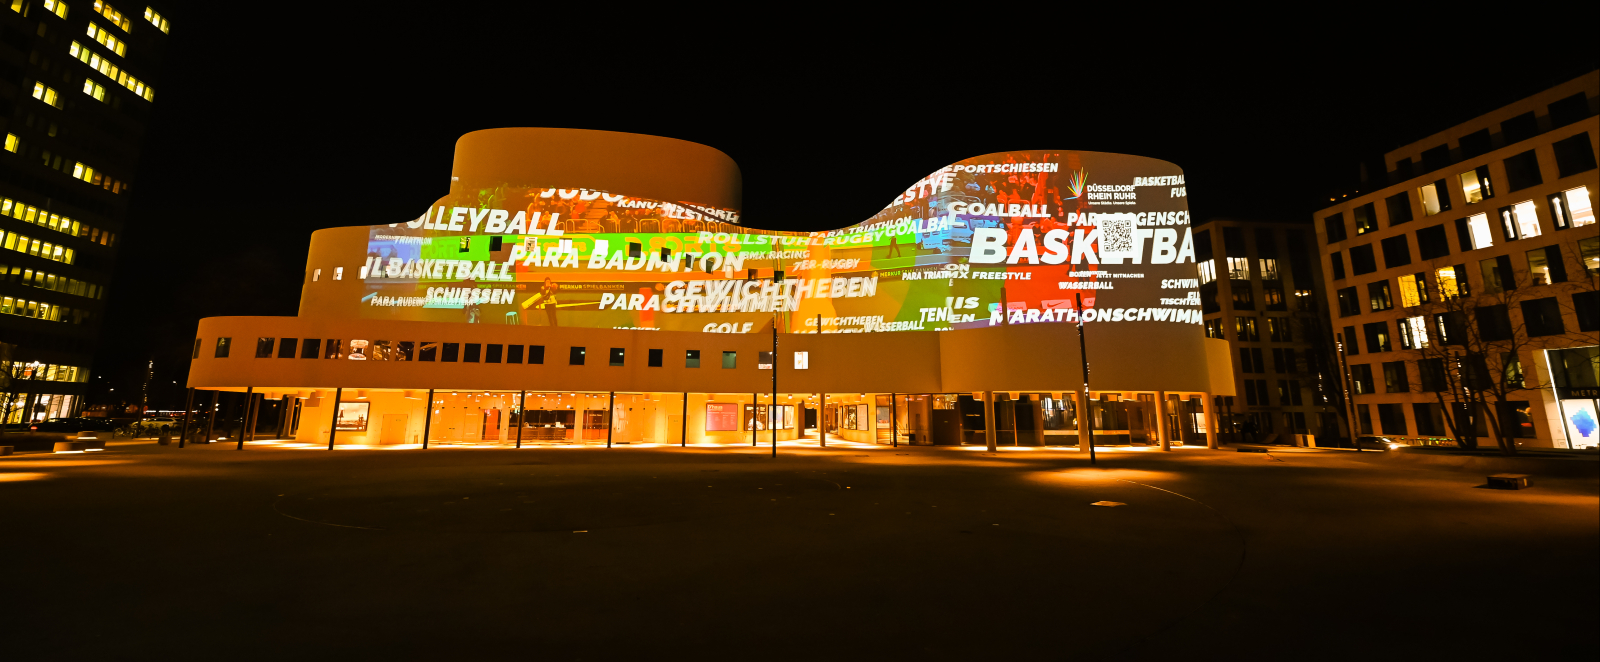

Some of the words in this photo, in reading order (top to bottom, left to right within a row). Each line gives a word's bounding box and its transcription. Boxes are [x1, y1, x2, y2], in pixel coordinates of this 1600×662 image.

[1086, 183, 1136, 192] DÜSSELDORF
[1088, 192, 1113, 200] RHEIN
[1113, 192, 1137, 200] RUHR
[388, 205, 564, 237] LLEYBALL
[848, 215, 913, 234] TRIATHLON
[508, 243, 580, 268] PARA
[968, 227, 1196, 265] BASKTBA
[386, 256, 514, 282] BASKETBALL
[902, 272, 922, 281] PARA
[971, 271, 1032, 280] FREESTYLE
[663, 276, 879, 303] GEWICHTHEBEN
[1058, 281, 1115, 290] WASSERBALL
[370, 295, 395, 307] PARA
[426, 286, 516, 305] SCHIESSEN
